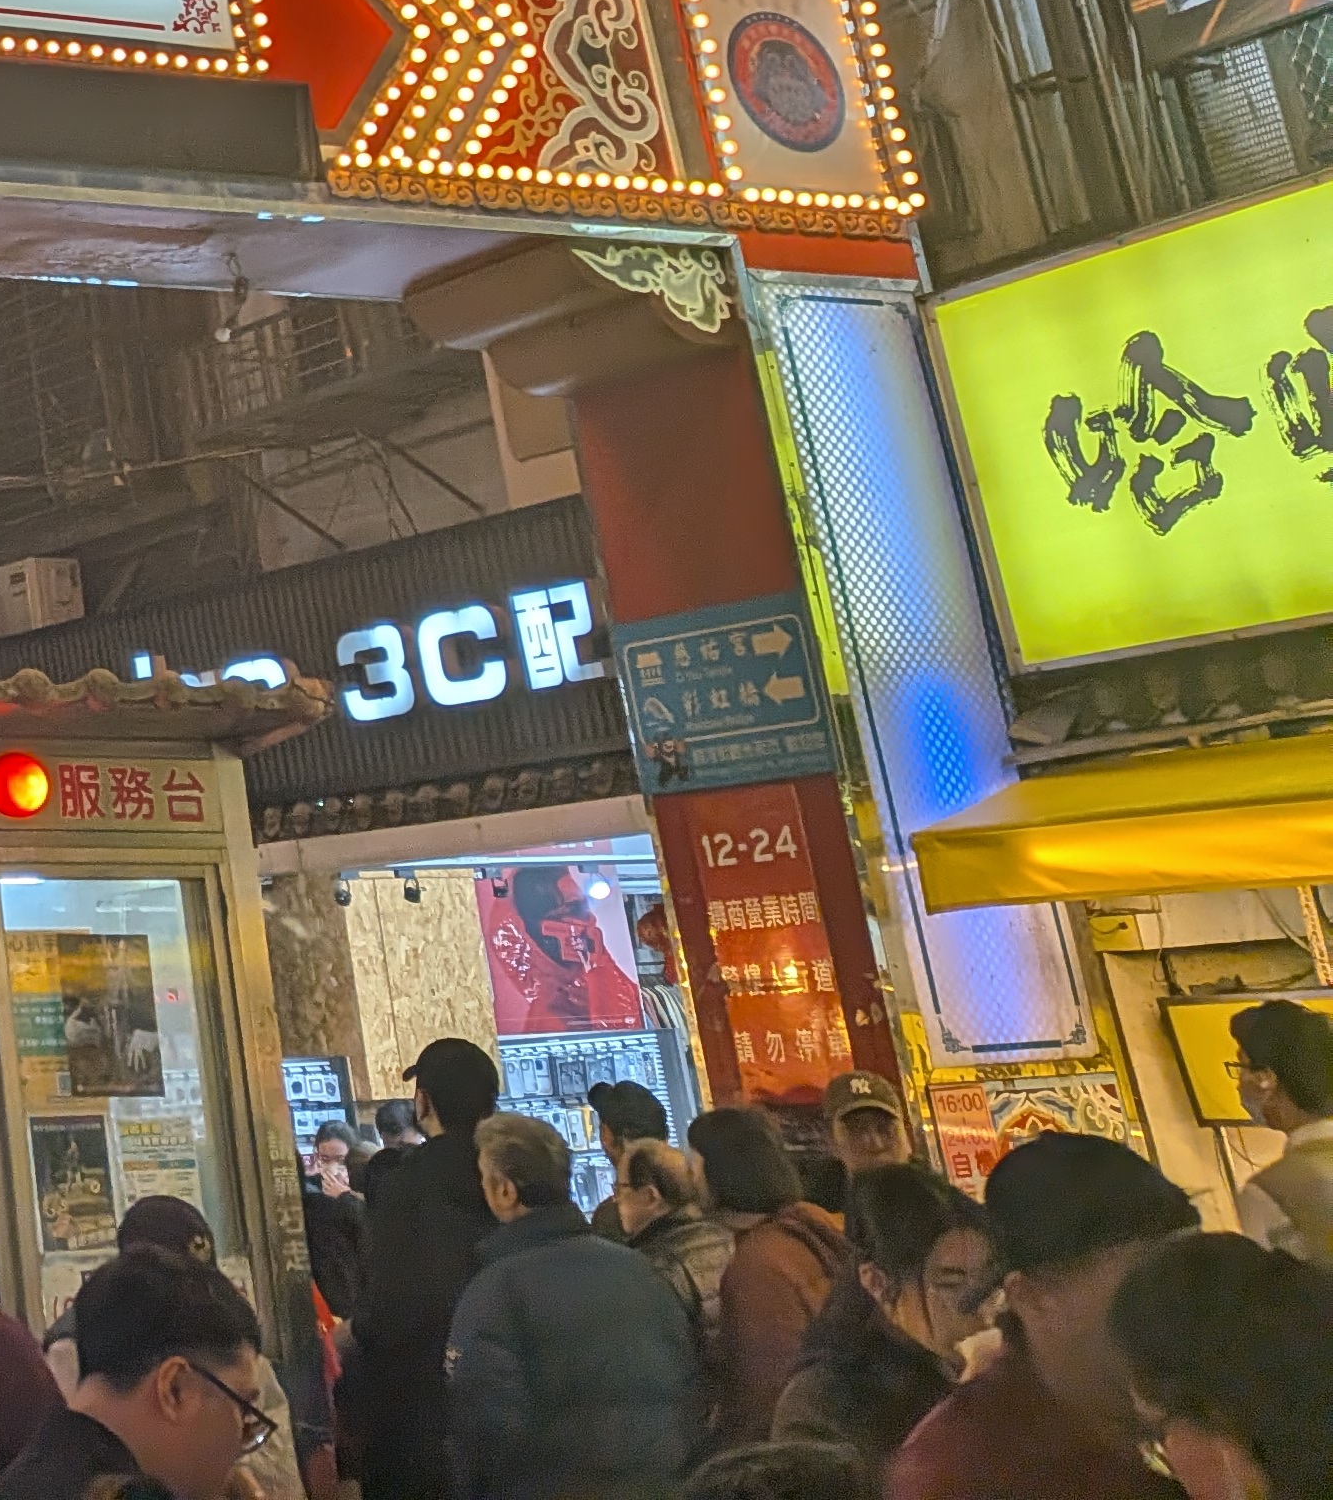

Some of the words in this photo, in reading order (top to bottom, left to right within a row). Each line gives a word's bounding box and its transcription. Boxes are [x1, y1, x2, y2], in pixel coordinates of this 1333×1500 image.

[336, 579, 607, 722] 3C配
[57, 761, 206, 825] 服務台
[938, 1093, 983, 1113] 16:00
